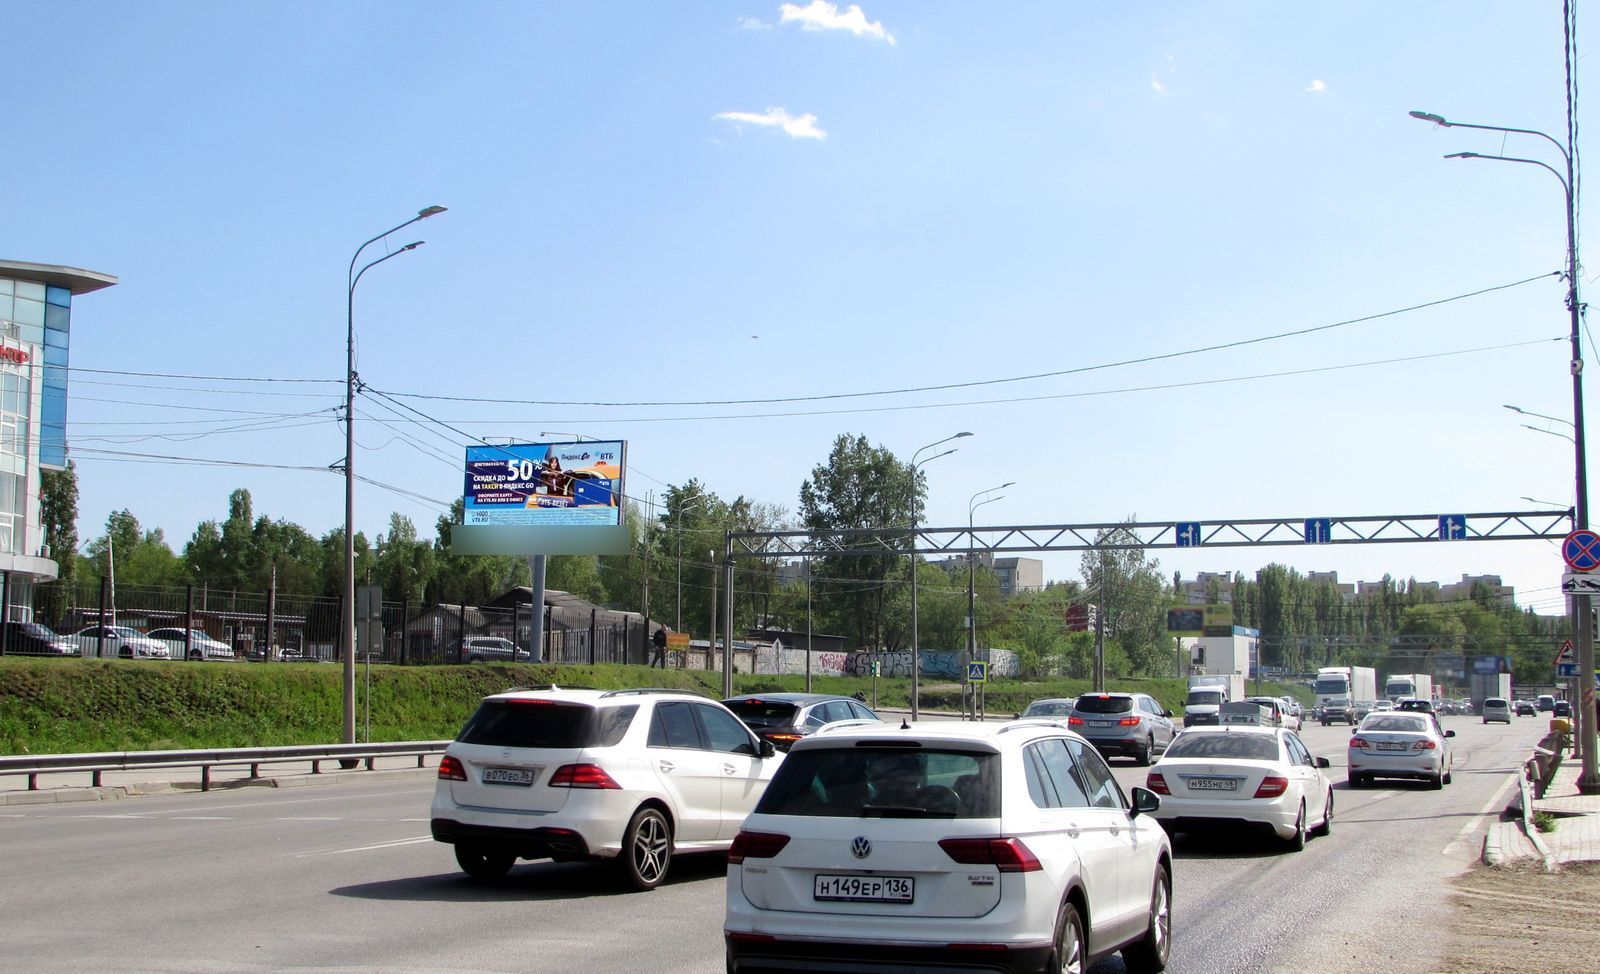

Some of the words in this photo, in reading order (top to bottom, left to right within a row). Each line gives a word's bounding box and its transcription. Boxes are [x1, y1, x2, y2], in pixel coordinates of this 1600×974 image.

[600, 452, 614, 460] ВТБ
[503, 482, 525, 490] ЯНДЕКС
[885, 880, 909, 892] 136
